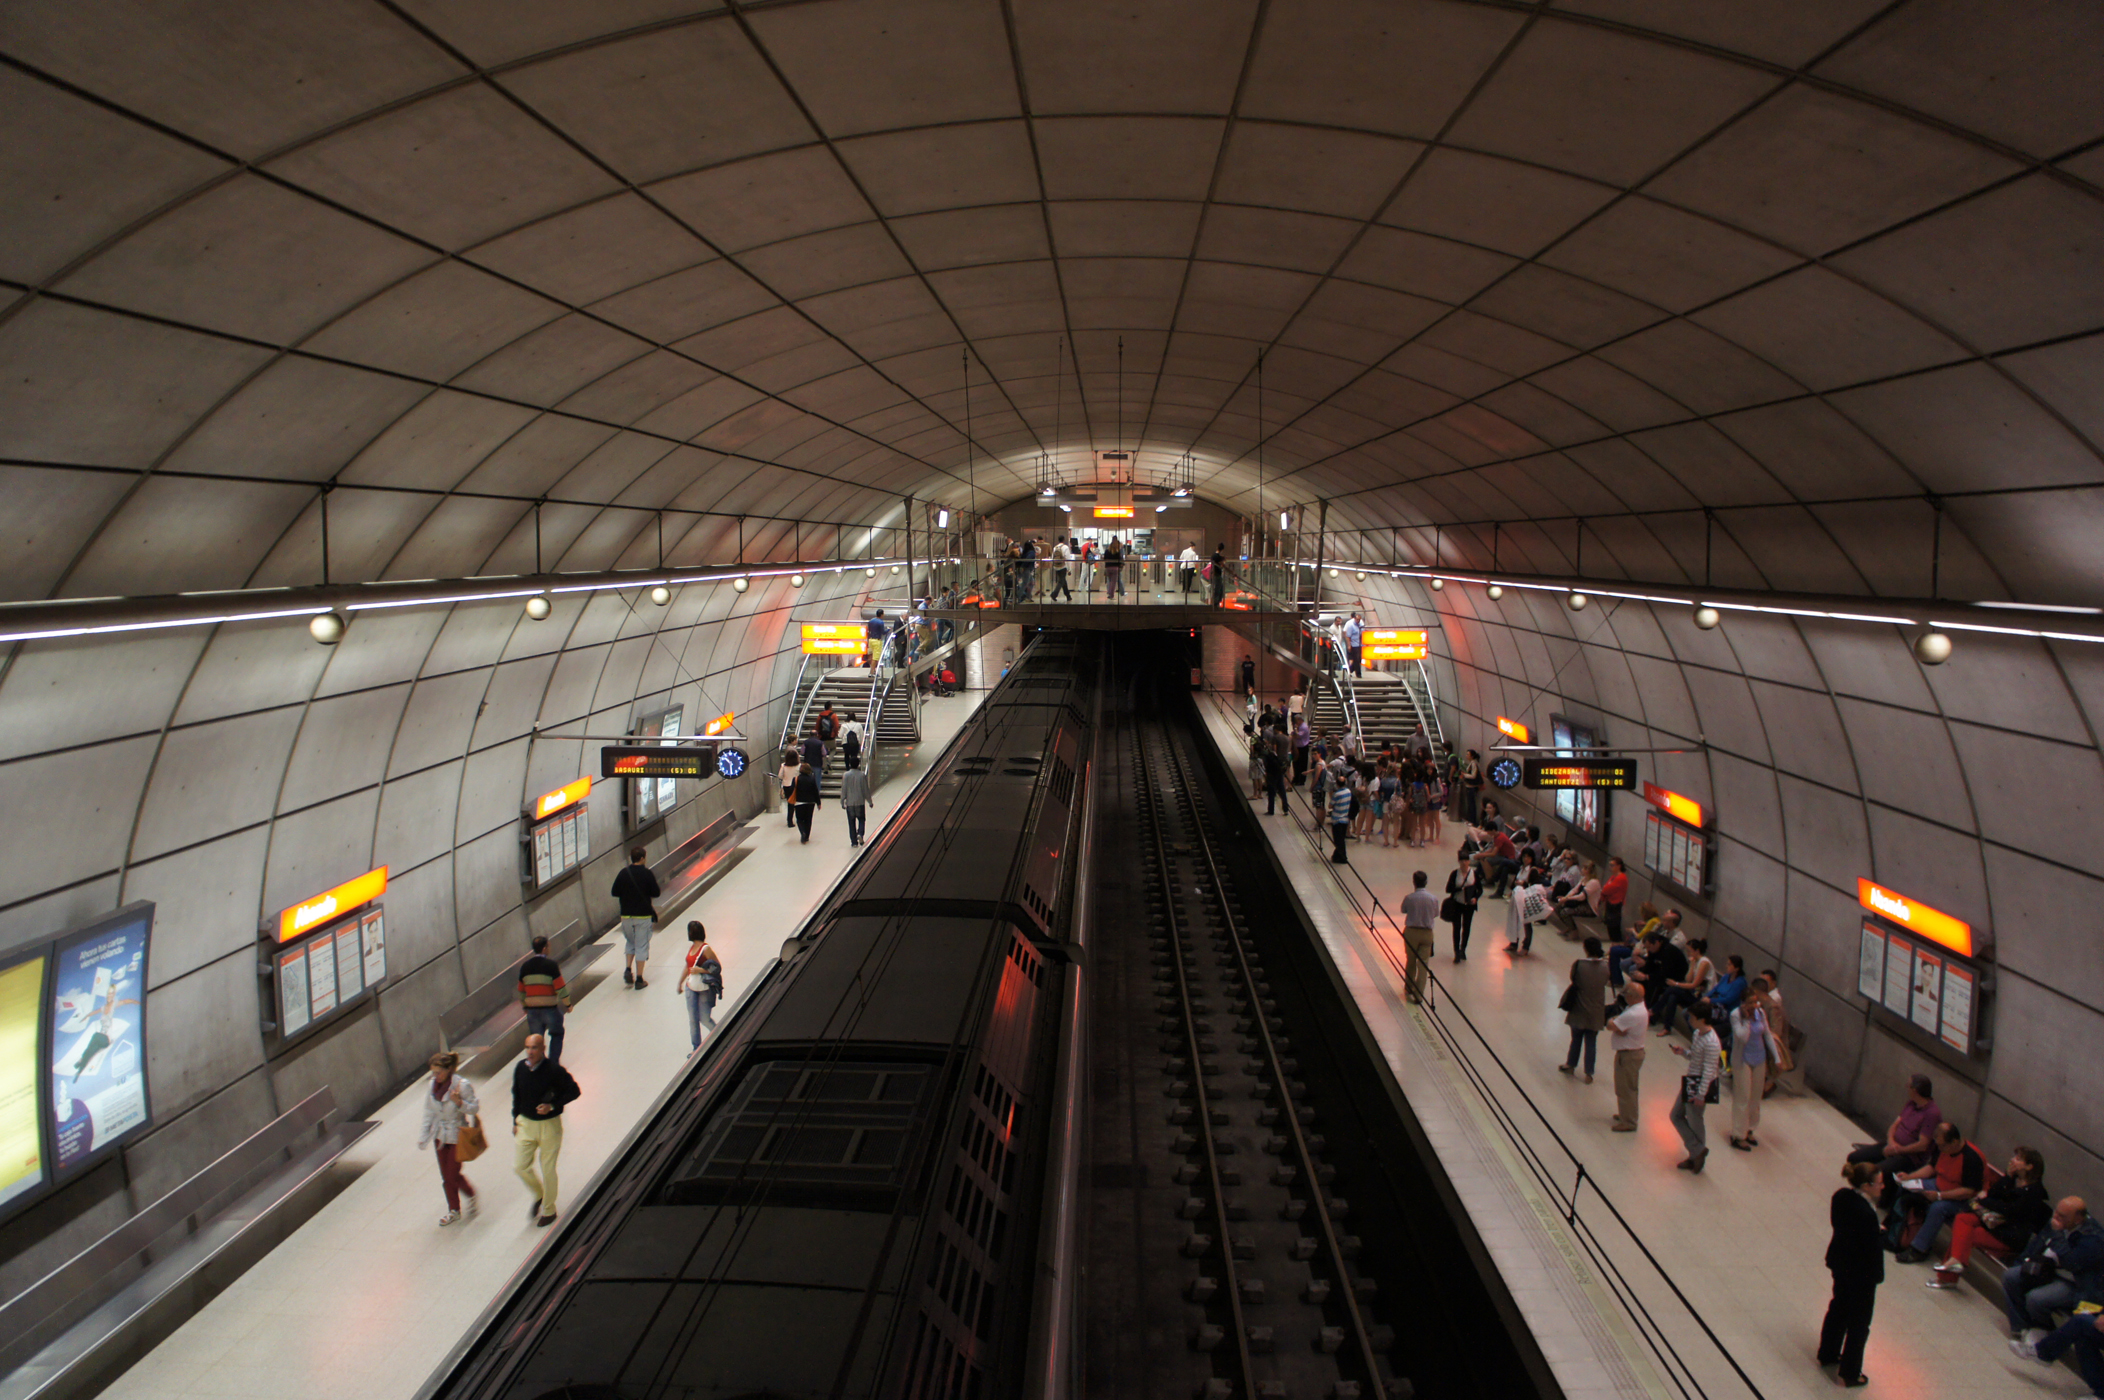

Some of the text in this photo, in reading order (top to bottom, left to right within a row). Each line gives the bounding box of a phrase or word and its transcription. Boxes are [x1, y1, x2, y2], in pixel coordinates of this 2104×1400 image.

[79, 935, 126, 961] Ahora tus cartas
[80, 945, 125, 969] vienen volando
